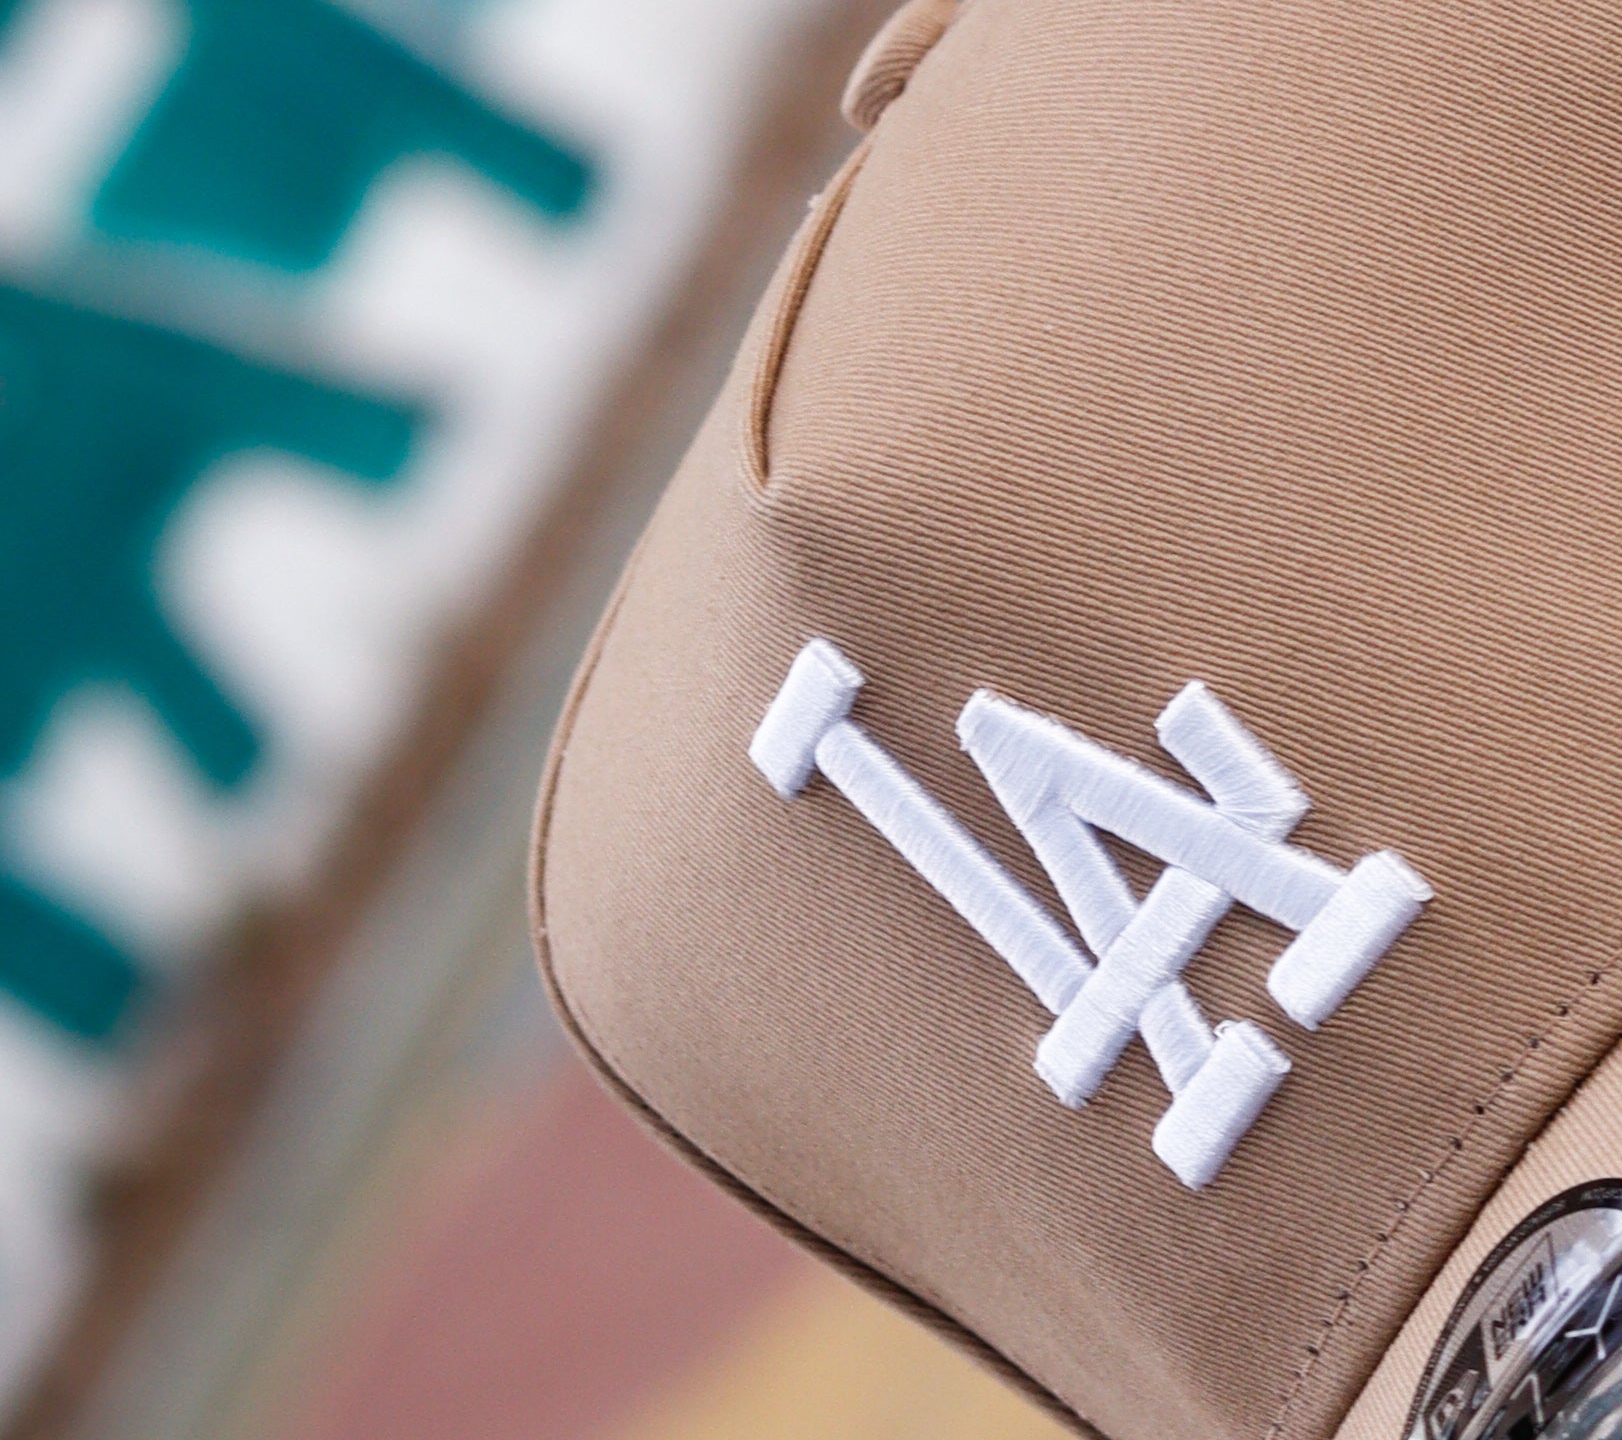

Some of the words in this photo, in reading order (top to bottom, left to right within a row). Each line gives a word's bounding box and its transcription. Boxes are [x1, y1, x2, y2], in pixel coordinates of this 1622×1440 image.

[748, 637, 1434, 1191] LA
[1491, 1262, 1543, 1339] NEW
[1493, 1283, 1547, 1360] ERA
